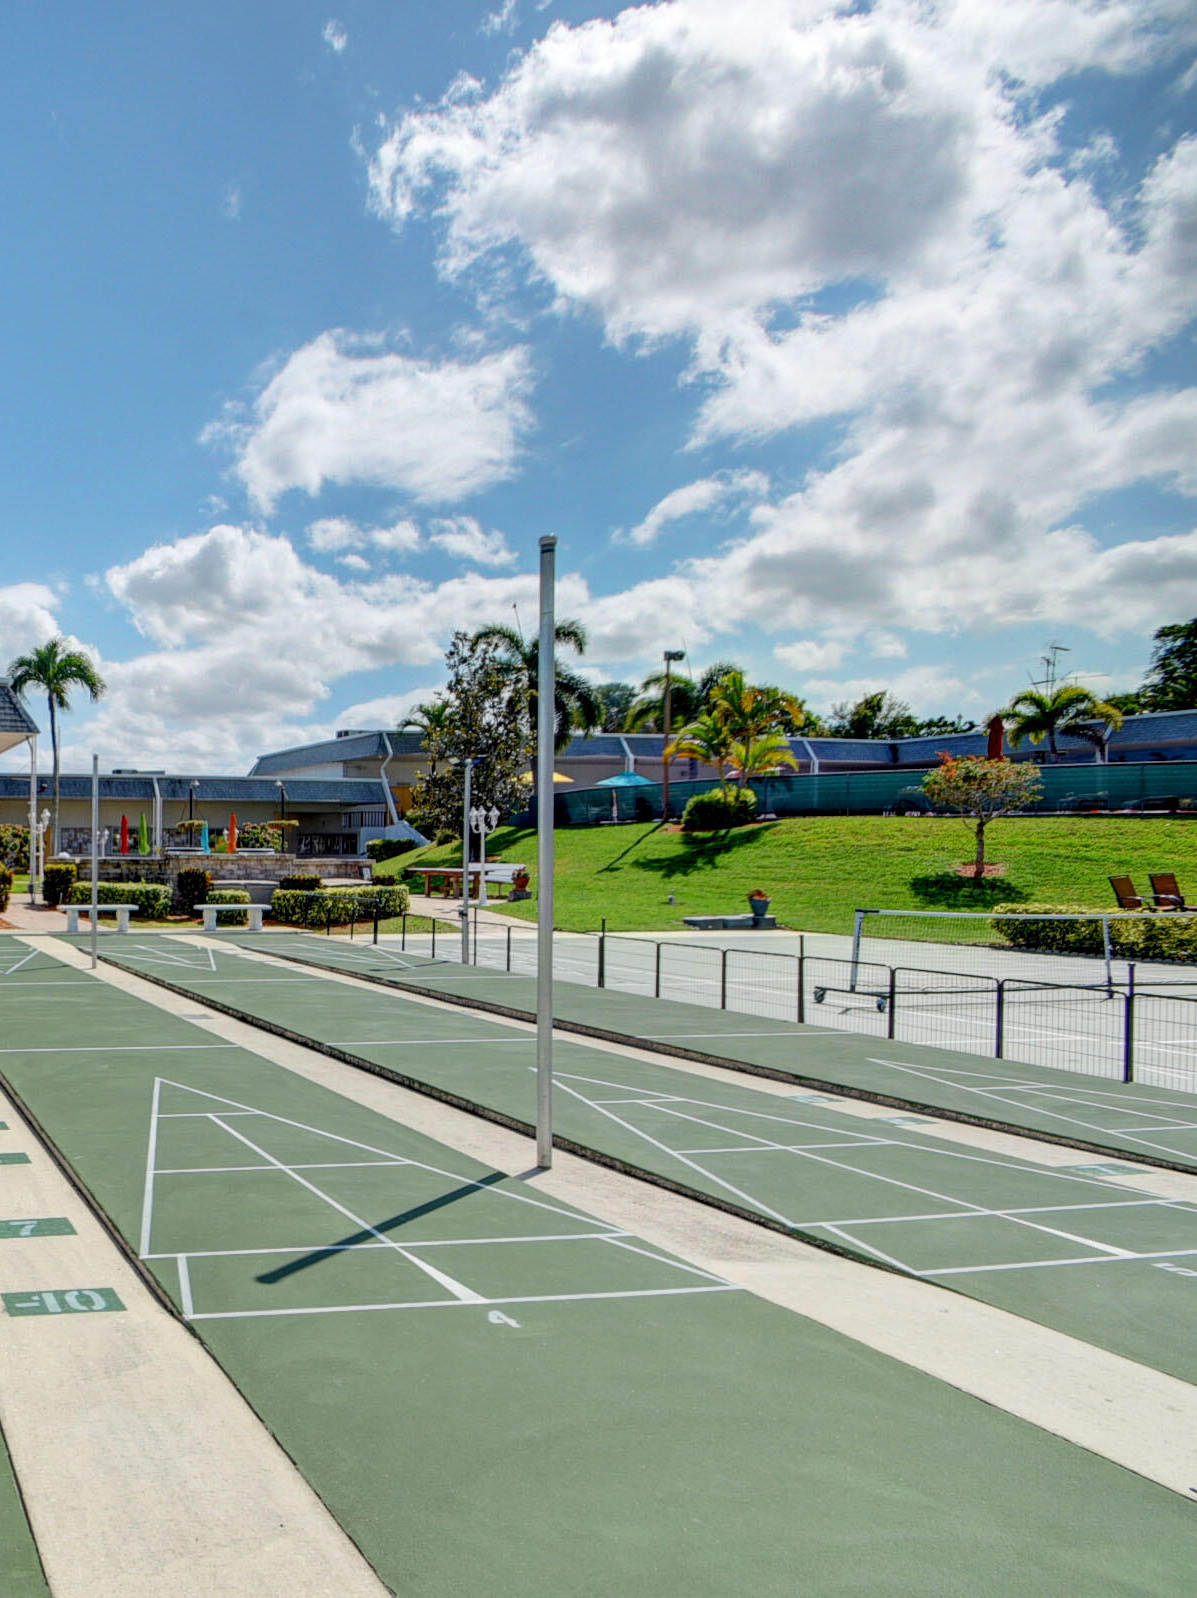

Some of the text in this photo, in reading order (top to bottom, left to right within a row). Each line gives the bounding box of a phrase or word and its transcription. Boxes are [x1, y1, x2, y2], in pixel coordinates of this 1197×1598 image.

[9, 1221, 38, 1236] 7
[14, 1290, 107, 1313] -10
[488, 1310, 522, 1328] 4
